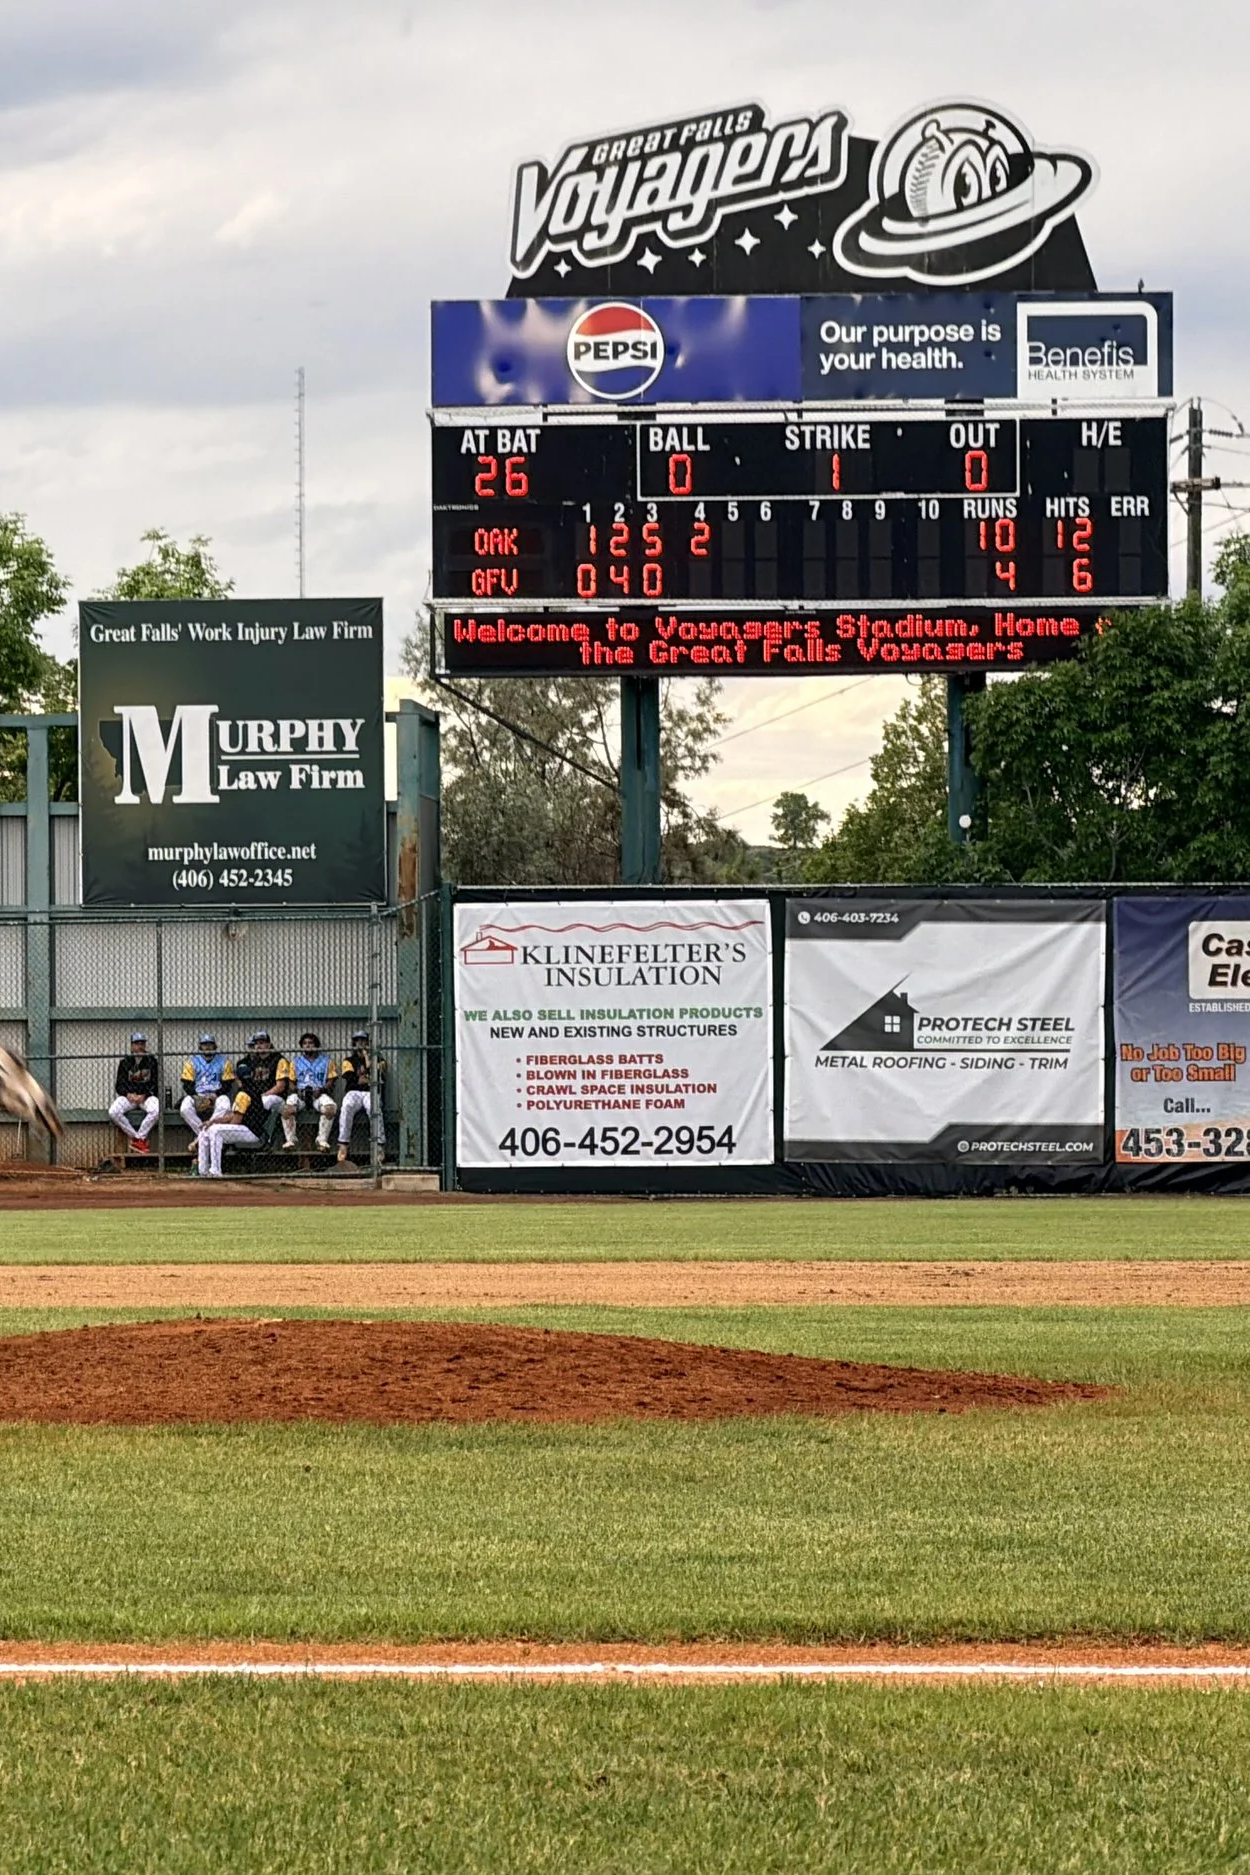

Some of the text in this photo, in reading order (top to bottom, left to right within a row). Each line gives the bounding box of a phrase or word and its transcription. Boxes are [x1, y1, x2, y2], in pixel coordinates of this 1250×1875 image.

[514, 114, 839, 262] Voyagers
[820, 319, 1001, 347] Our purpose is
[573, 341, 657, 360] PEPSI
[819, 348, 964, 375] your health.
[1027, 341, 1134, 367] Benefis
[1028, 368, 1135, 381] HEALTH SYSTEM
[461, 428, 541, 453] AT BAT
[650, 426, 710, 451] BALL
[785, 424, 871, 450] STRIKE
[950, 423, 1000, 448] OUT
[1081, 421, 1122, 447] H/E
[475, 456, 529, 496] 26
[669, 454, 692, 495] 0
[965, 450, 988, 492] 0
[582, 496, 1150, 523] 1 2 3 4 5 6 7 8 9 10 RUNS HITS ERR
[475, 517, 1093, 557] OAK 2 5 2 10 12
[471, 557, 1093, 598] GFV 0 4 0 4 6
[90, 621, 373, 644] Great Falls' Work Injury Law Firm
[454, 619, 590, 643] Welcome
[606, 617, 640, 641] to
[655, 615, 821, 641] Voyagers
[836, 613, 979, 639] Stadium,
[994, 612, 1080, 637] Home
[580, 637, 1024, 664] the Great Falls Voyagers
[114, 705, 365, 804] MURPHY
[217, 764, 365, 790] Law Firm
[148, 842, 317, 865] murphylawoffice.net
[172, 869, 293, 890] (406) 452-2345
[813, 912, 899, 923] 406-403-7234
[544, 965, 722, 987] INSULATION
[464, 1006, 763, 1022] WE ALSO SELL INSULATION PRODUCTS
[1189, 1002, 1250, 1013] ESTABLISHED
[490, 1024, 738, 1039] NEW AND EXISTING STRUCTURES
[917, 1017, 1075, 1032] PROTECH STEEL
[917, 1035, 1073, 1045] COMMITTED TO EXCELLENCE
[526, 1054, 664, 1066] FIBERGLASS BATTS
[814, 1055, 1068, 1070] METAL ROOFING SIDING TRIM
[1120, 1043, 1247, 1064] No Job Too Big
[526, 1068, 689, 1081] BLOWN IN FIBERGLASS
[1131, 1064, 1236, 1082] or Too Small
[526, 1083, 717, 1096] CRAWL SPACE INSULATION
[526, 1099, 685, 1111] POLYURETHANE FOAM
[1163, 1098, 1211, 1113] Call...
[499, 1125, 737, 1157] 406-452-2954
[971, 1142, 1094, 1152] PROTECHSTEEL.COM
[1122, 1127, 1250, 1158] 453-32
